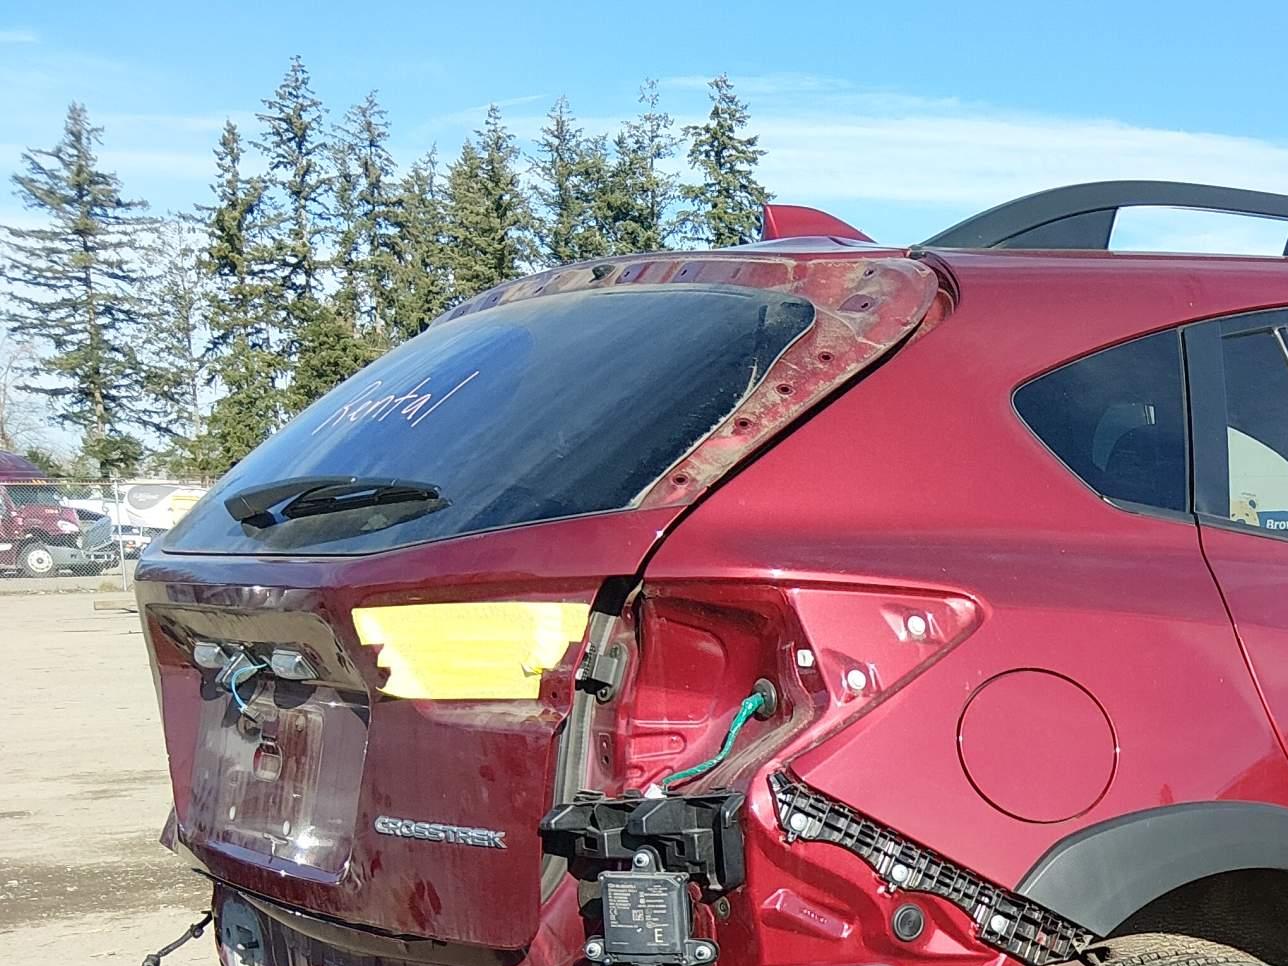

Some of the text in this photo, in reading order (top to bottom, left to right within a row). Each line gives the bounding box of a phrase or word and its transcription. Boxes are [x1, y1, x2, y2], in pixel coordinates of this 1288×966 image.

[311, 370, 480, 436] Rental
[374, 815, 508, 849] CROSSTREK
[654, 928, 665, 943] E
